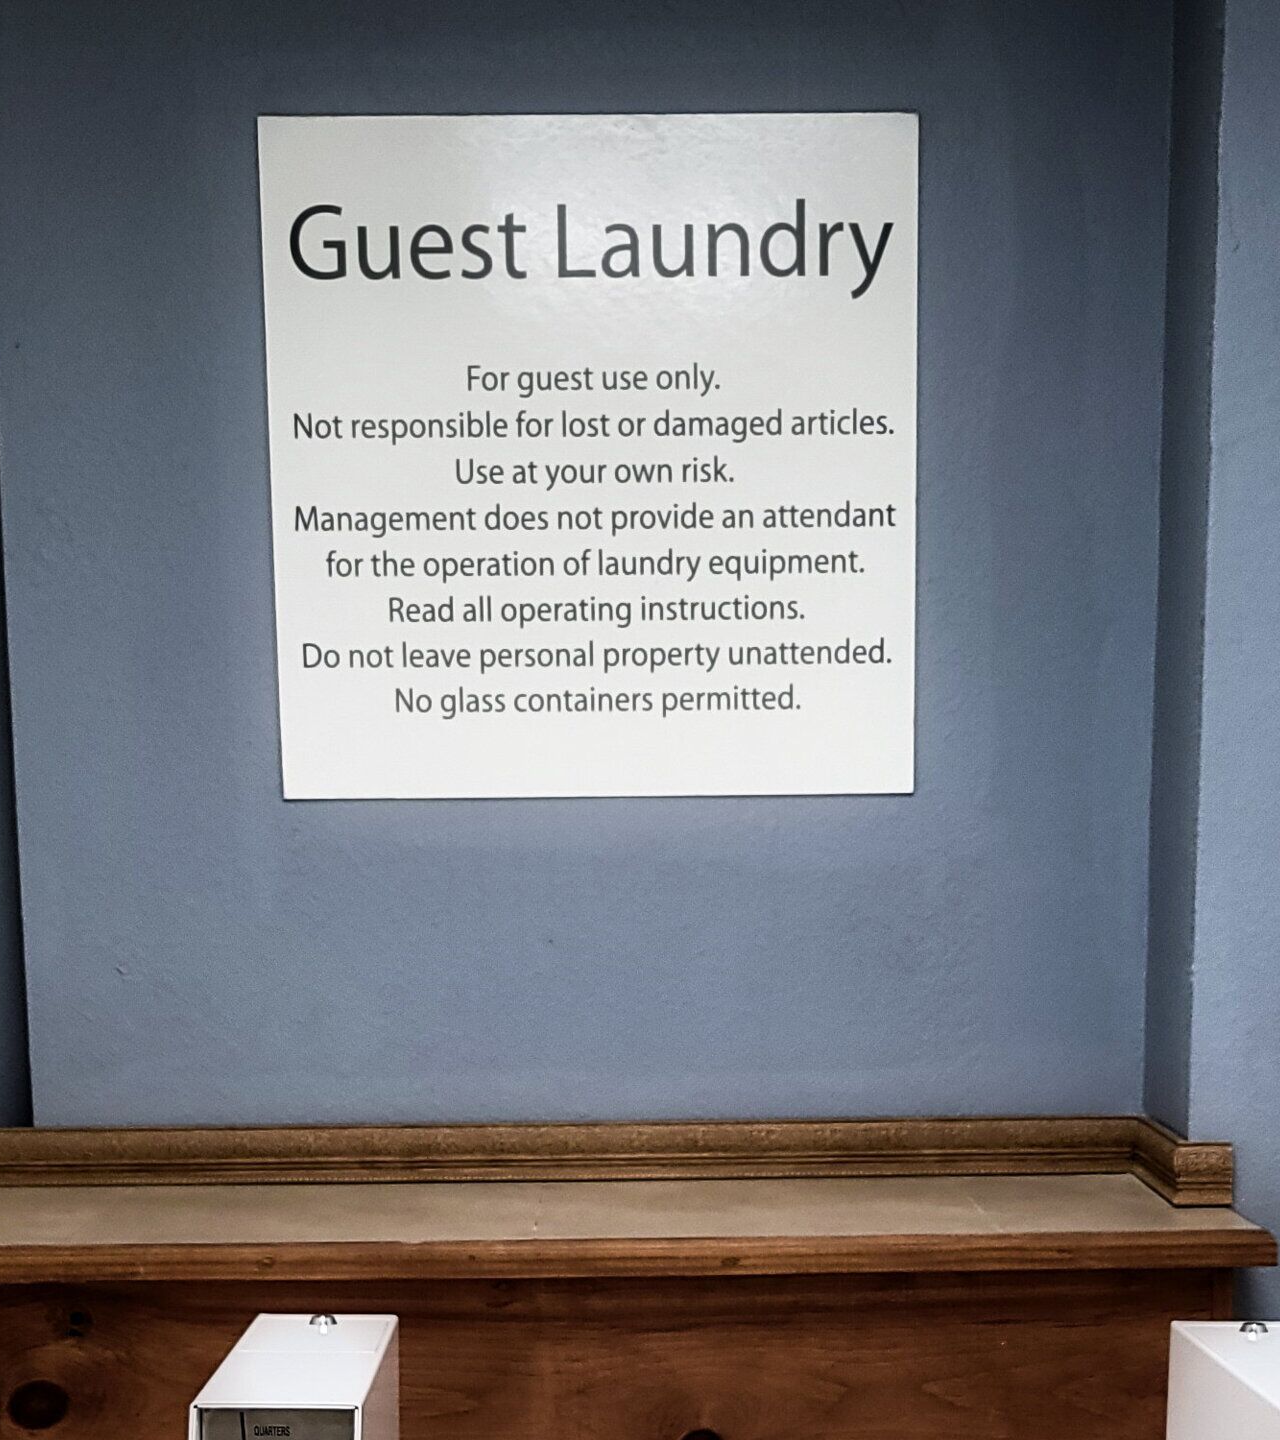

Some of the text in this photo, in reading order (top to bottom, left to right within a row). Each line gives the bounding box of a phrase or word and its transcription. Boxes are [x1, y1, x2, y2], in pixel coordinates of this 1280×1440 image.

[288, 197, 895, 300] Guest Laundry
[466, 361, 721, 399] For guest use only.
[292, 407, 895, 446] Not responsible for lost or damaged articles.
[455, 454, 735, 492] Use at your own risk.
[294, 499, 897, 539] Management does not provide an attendant
[325, 547, 865, 585] for the operation of laundry equipment.
[388, 593, 806, 630] Read all operating instructions.
[302, 636, 893, 675] Do not leave personal property unattended.
[394, 682, 801, 721] No glass containers permitted.
[253, 1425, 291, 1437] QUARTERS
